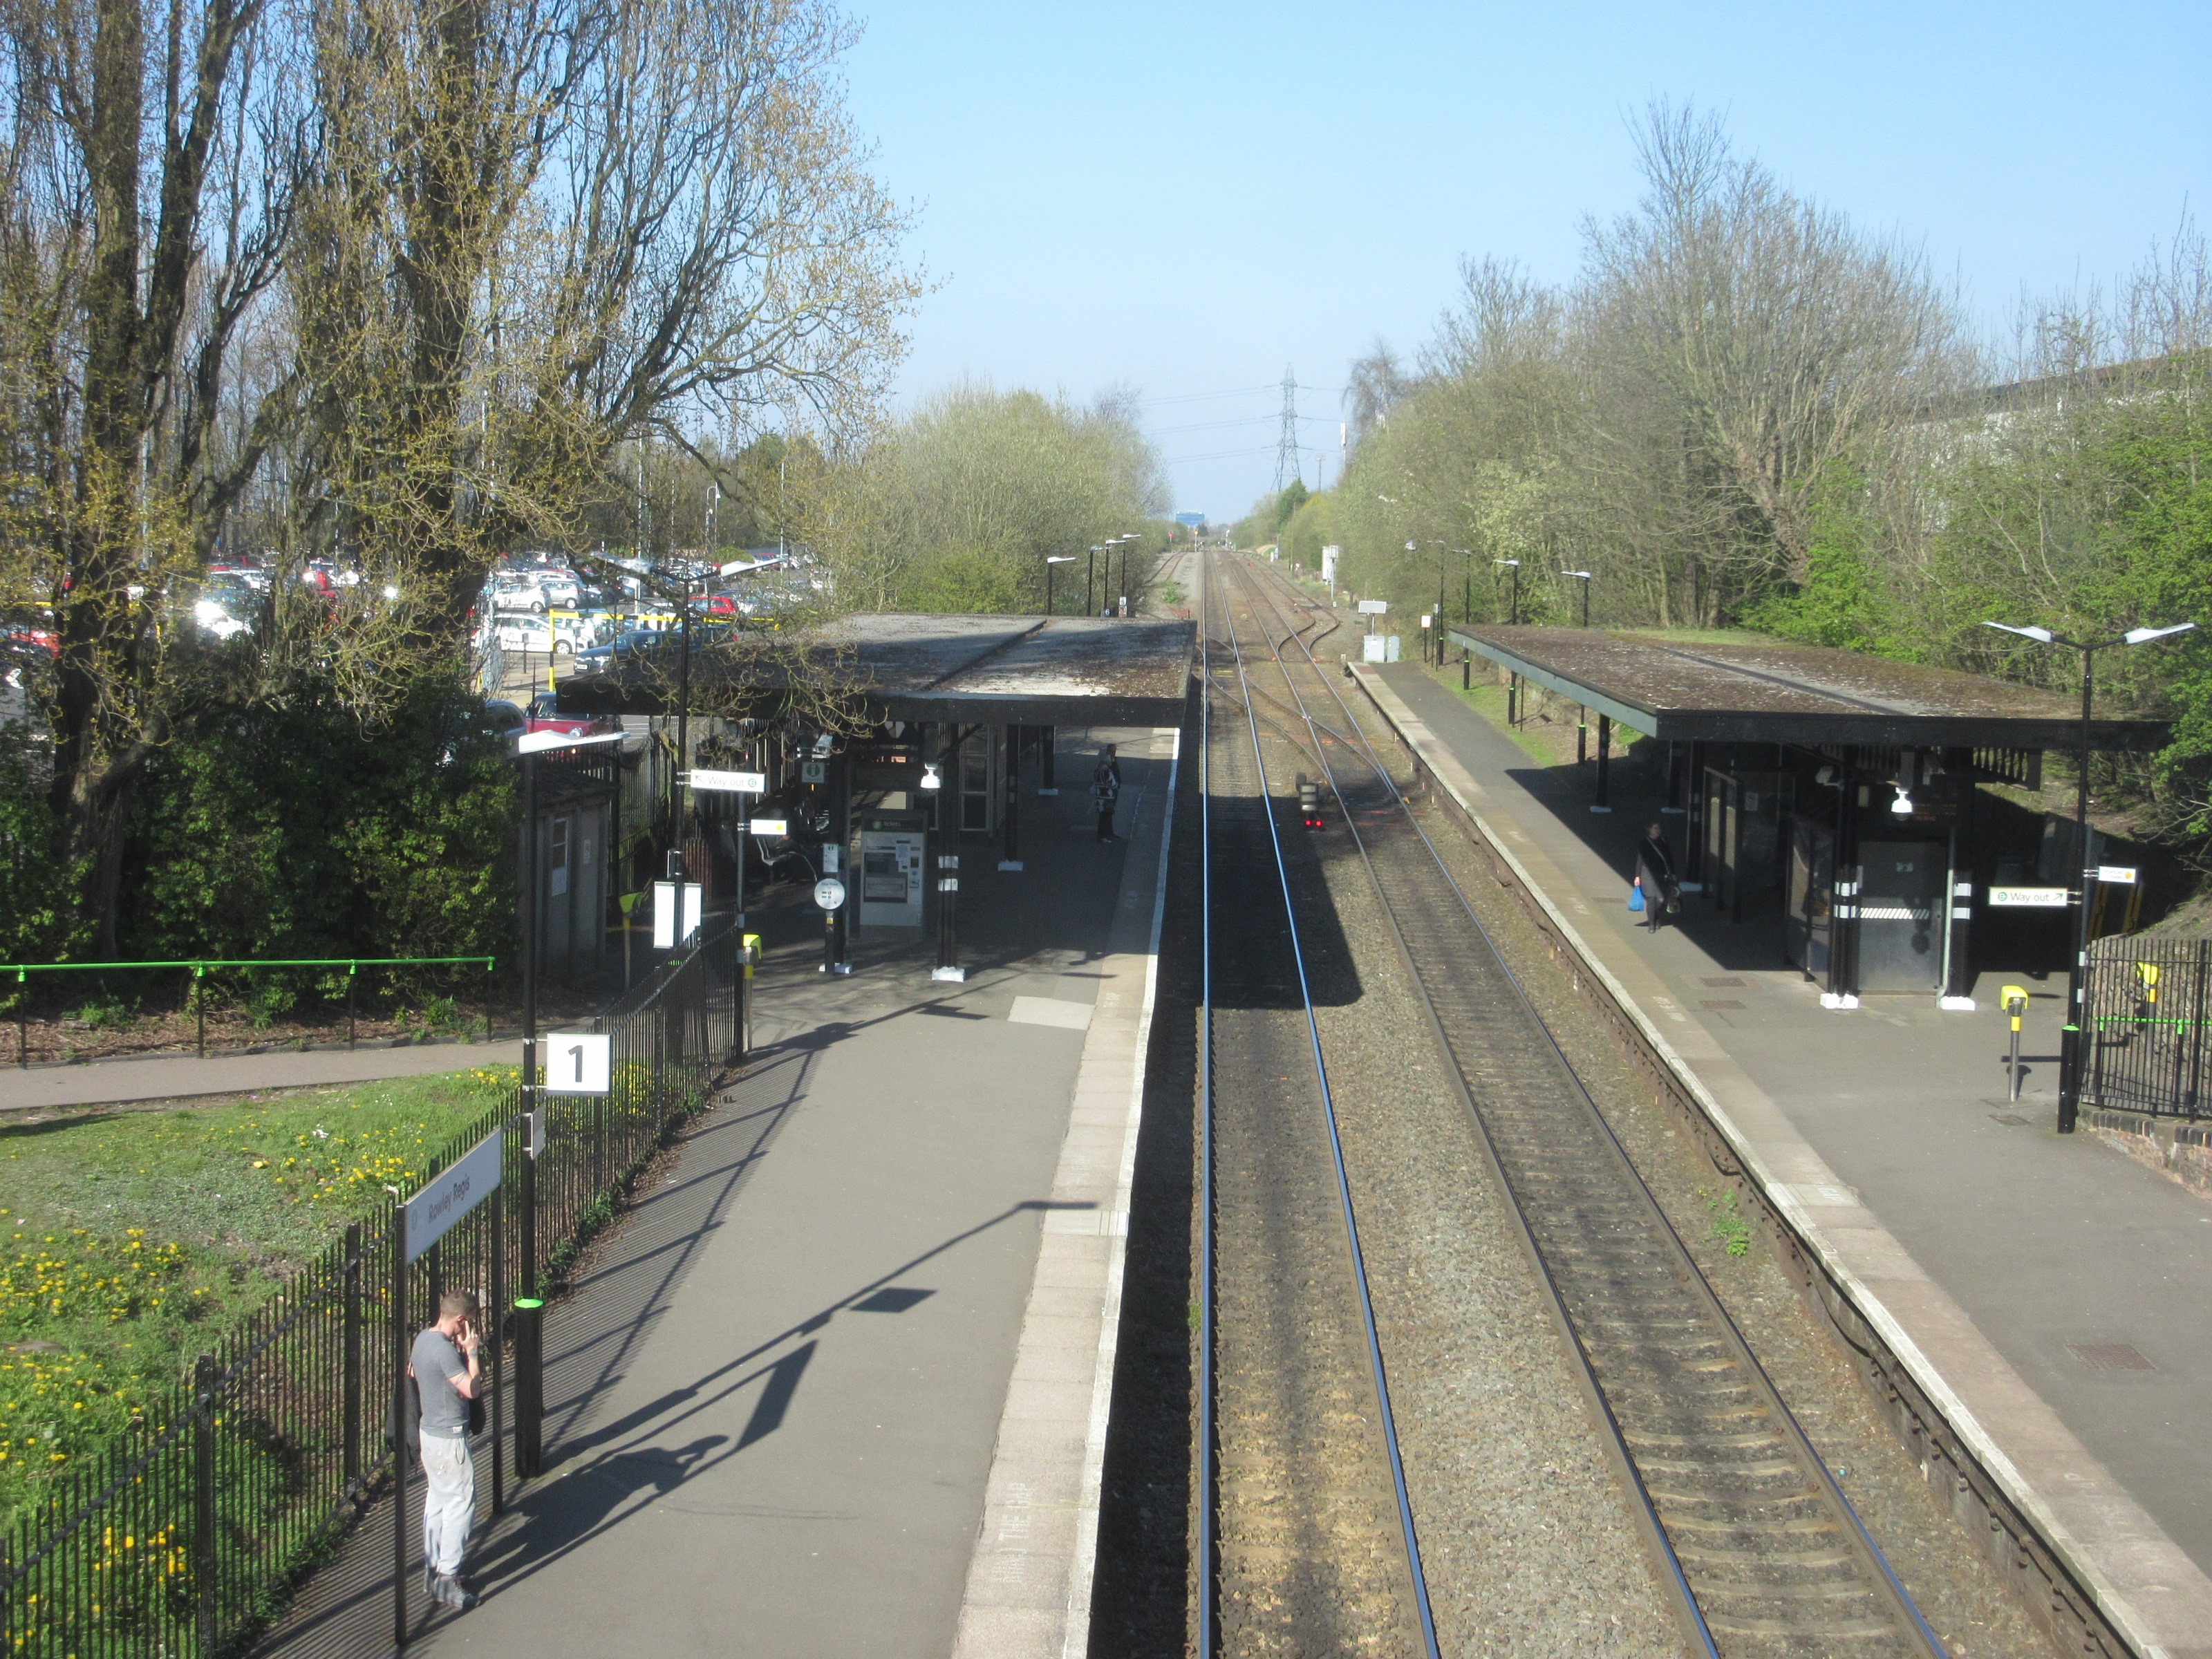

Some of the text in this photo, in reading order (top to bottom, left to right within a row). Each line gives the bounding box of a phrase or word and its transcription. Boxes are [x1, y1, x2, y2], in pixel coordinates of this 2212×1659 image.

[708, 776, 744, 787] Way out
[2011, 892, 2030, 903] Way
[568, 1045, 583, 1082] 1
[429, 1173, 470, 1224] Rowley Regis
